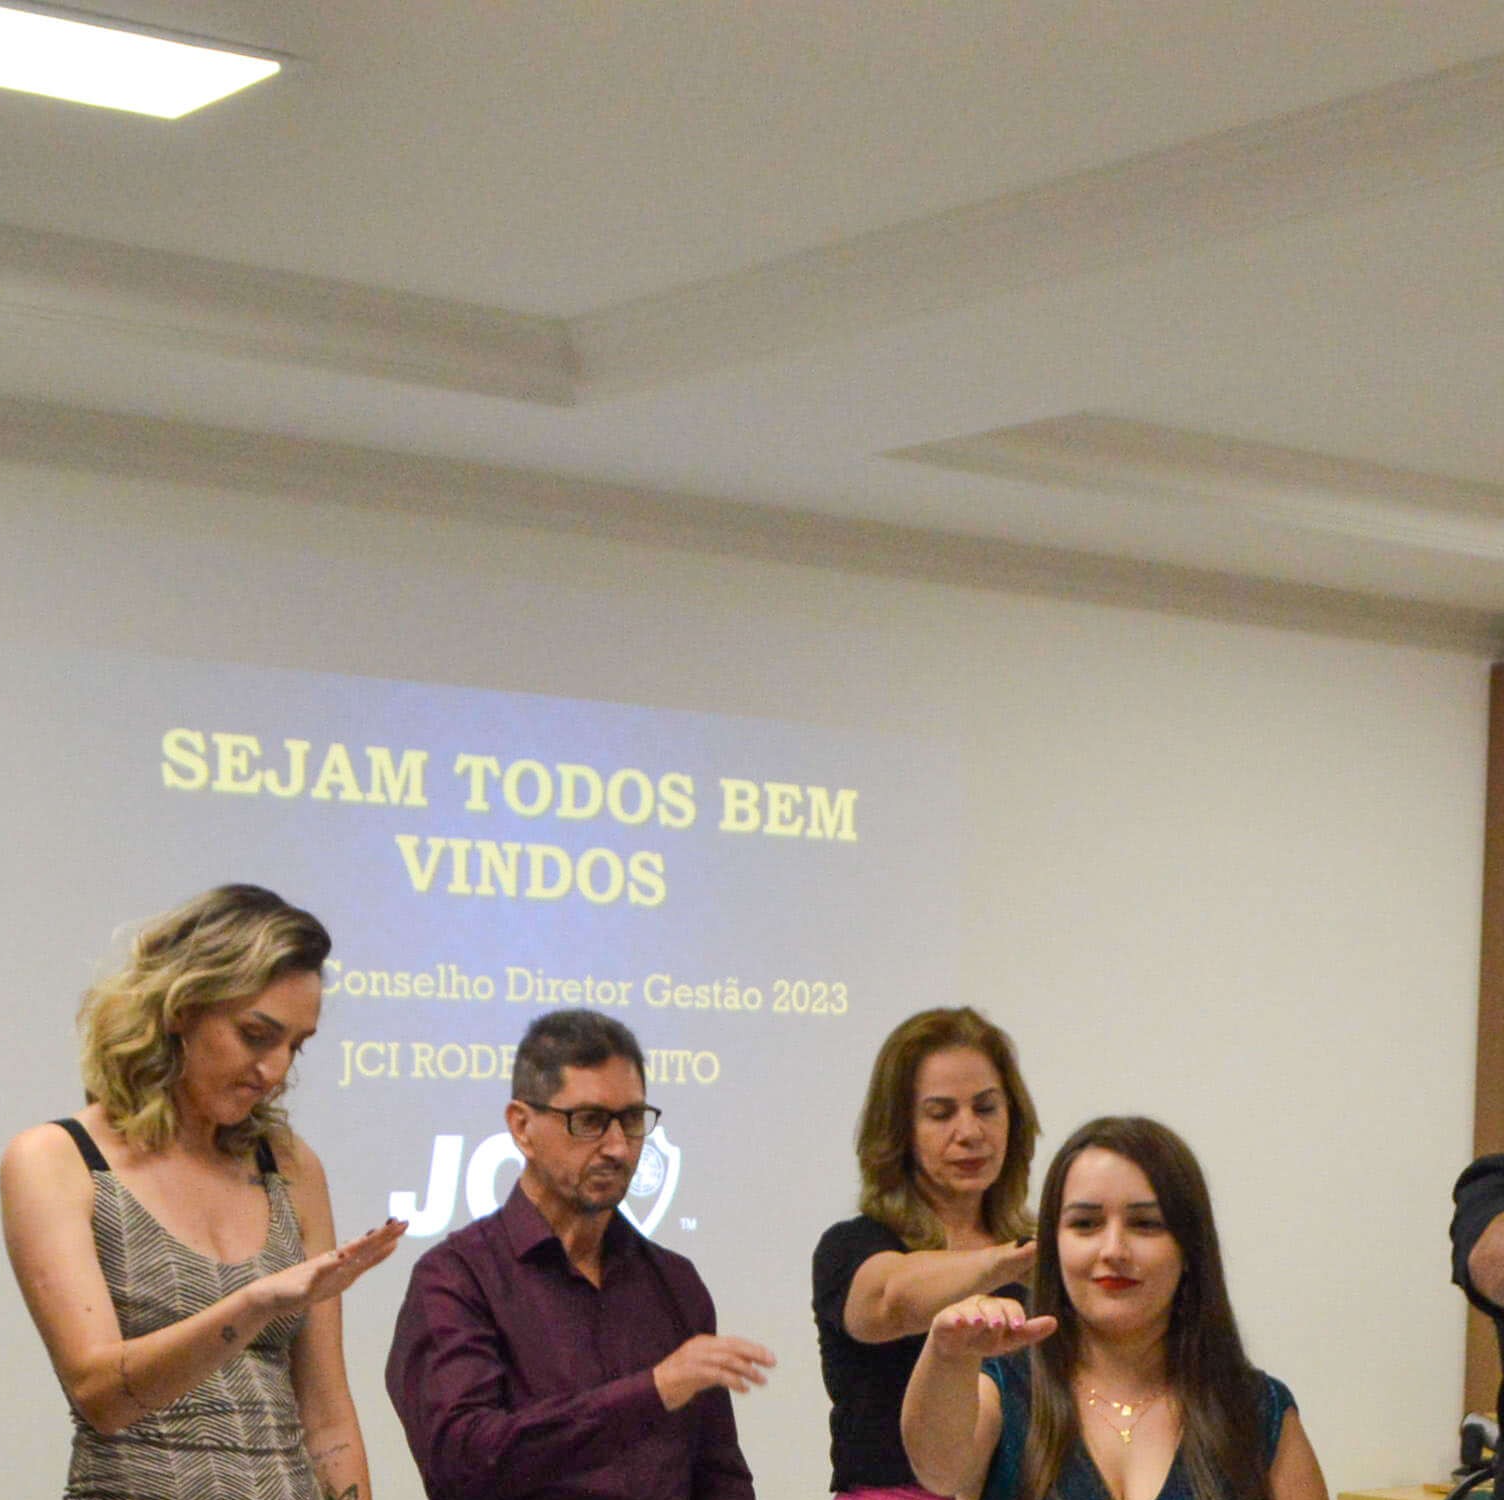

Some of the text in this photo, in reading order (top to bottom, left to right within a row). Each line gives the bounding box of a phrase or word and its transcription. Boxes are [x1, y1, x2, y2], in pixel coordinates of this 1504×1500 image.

[162, 728, 861, 845] SEJAM TODOS BEM
[398, 836, 666, 906] VINDOS
[323, 960, 850, 1016] Conselho Diretor Gestão 2023
[339, 1041, 400, 1086] JCI
